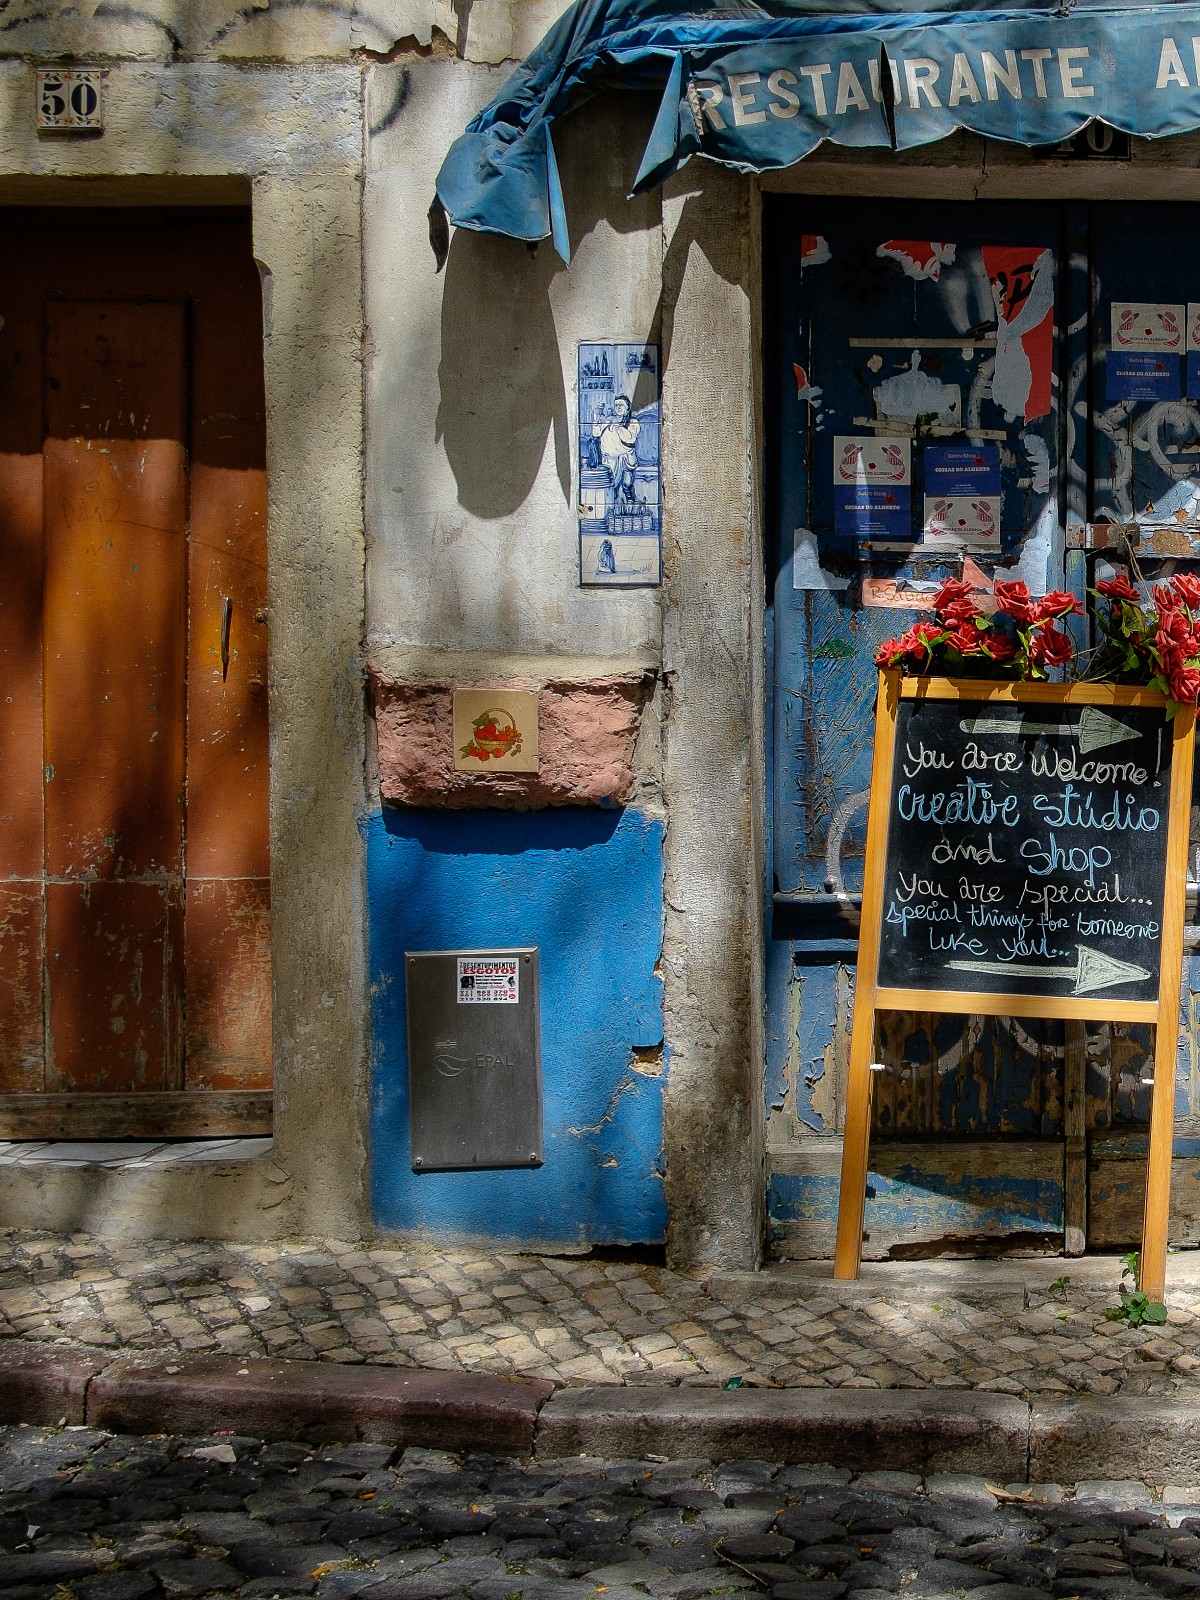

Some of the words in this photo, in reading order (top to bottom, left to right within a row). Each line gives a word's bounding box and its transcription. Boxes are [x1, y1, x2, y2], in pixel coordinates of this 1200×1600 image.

[41, 83, 98, 116] 50
[688, 46, 1095, 135] RESTAURANTE
[961, 741, 1023, 773] are
[898, 776, 1021, 827] Creative
[931, 832, 1006, 865] and
[1019, 832, 1112, 890] Shop
[959, 876, 1005, 903] are
[885, 902, 963, 936] special
[967, 904, 1034, 940] things
[1036, 911, 1070, 938] for
[1076, 912, 1161, 940] someone
[475, 1052, 514, 1068] EPAL
